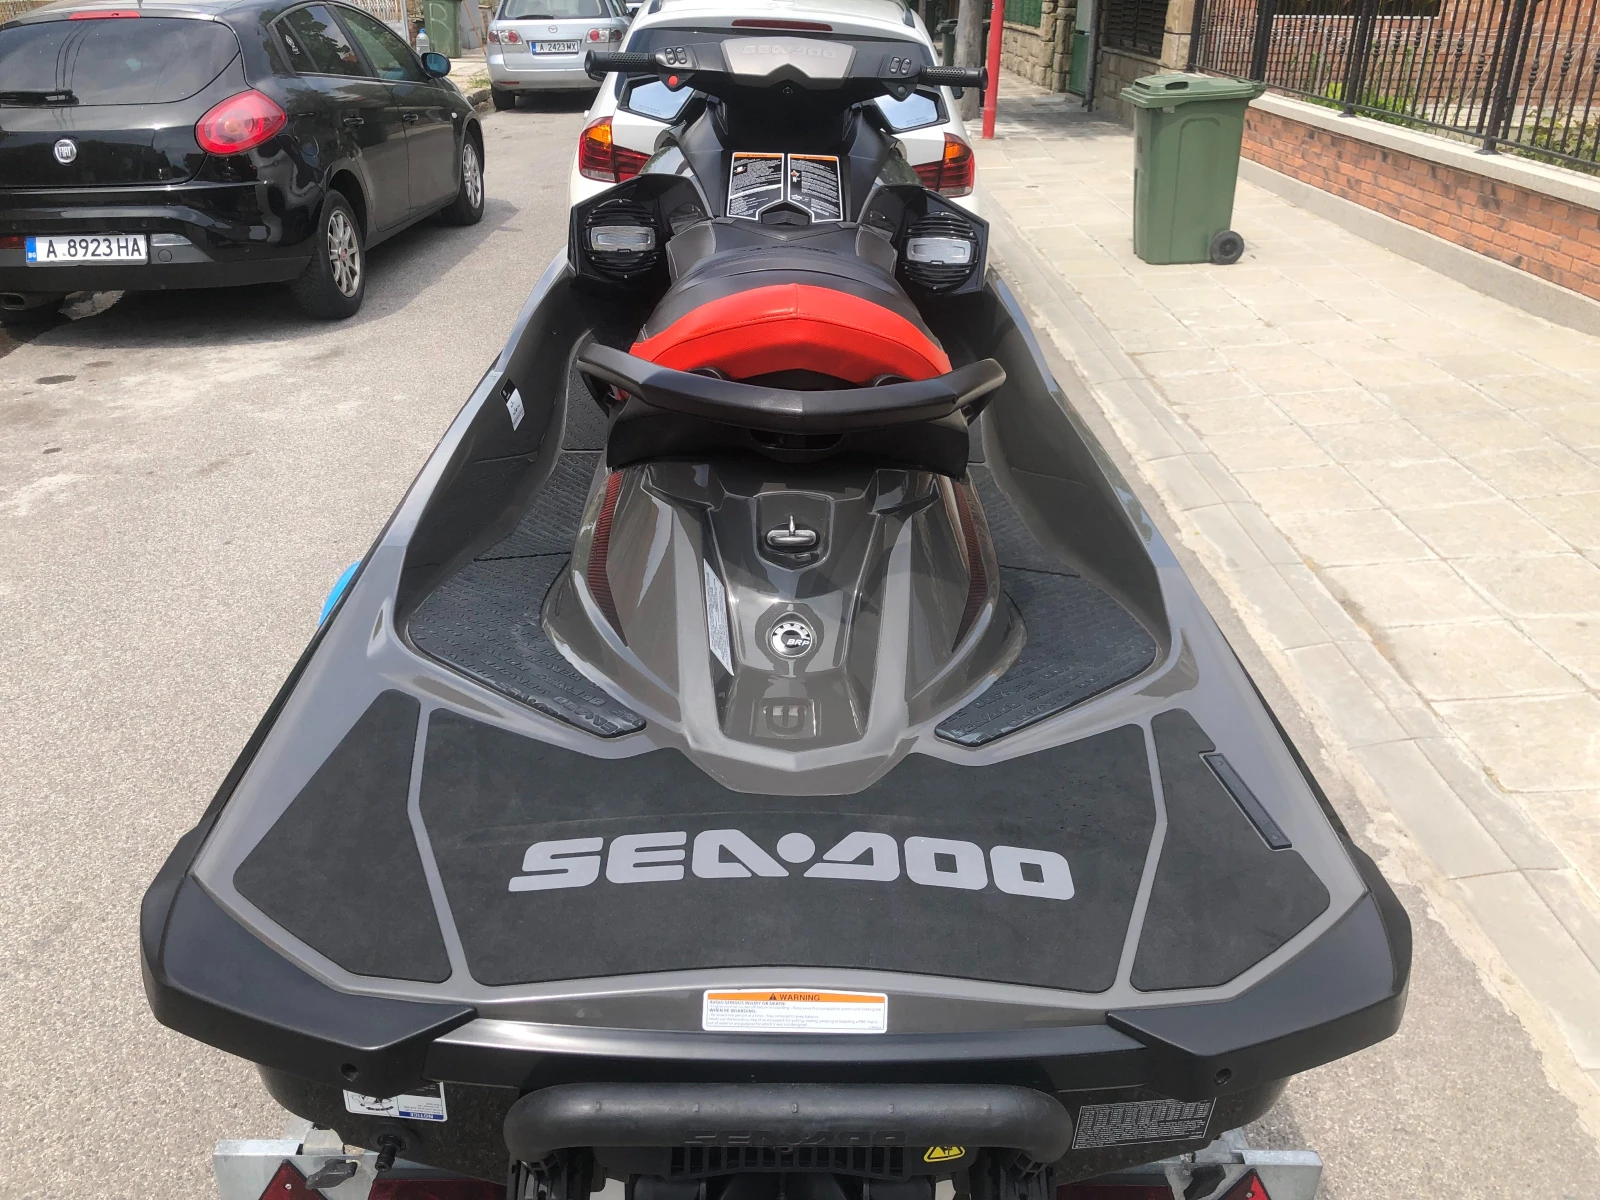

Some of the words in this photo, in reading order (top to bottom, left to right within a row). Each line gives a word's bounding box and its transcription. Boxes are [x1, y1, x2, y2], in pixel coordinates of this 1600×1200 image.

[540, 43, 544, 51] A
[547, 43, 566, 51] 2423
[46, 239, 57, 258] A
[67, 238, 113, 257] 8923
[116, 237, 142, 256] HA
[787, 638, 810, 646] BRP
